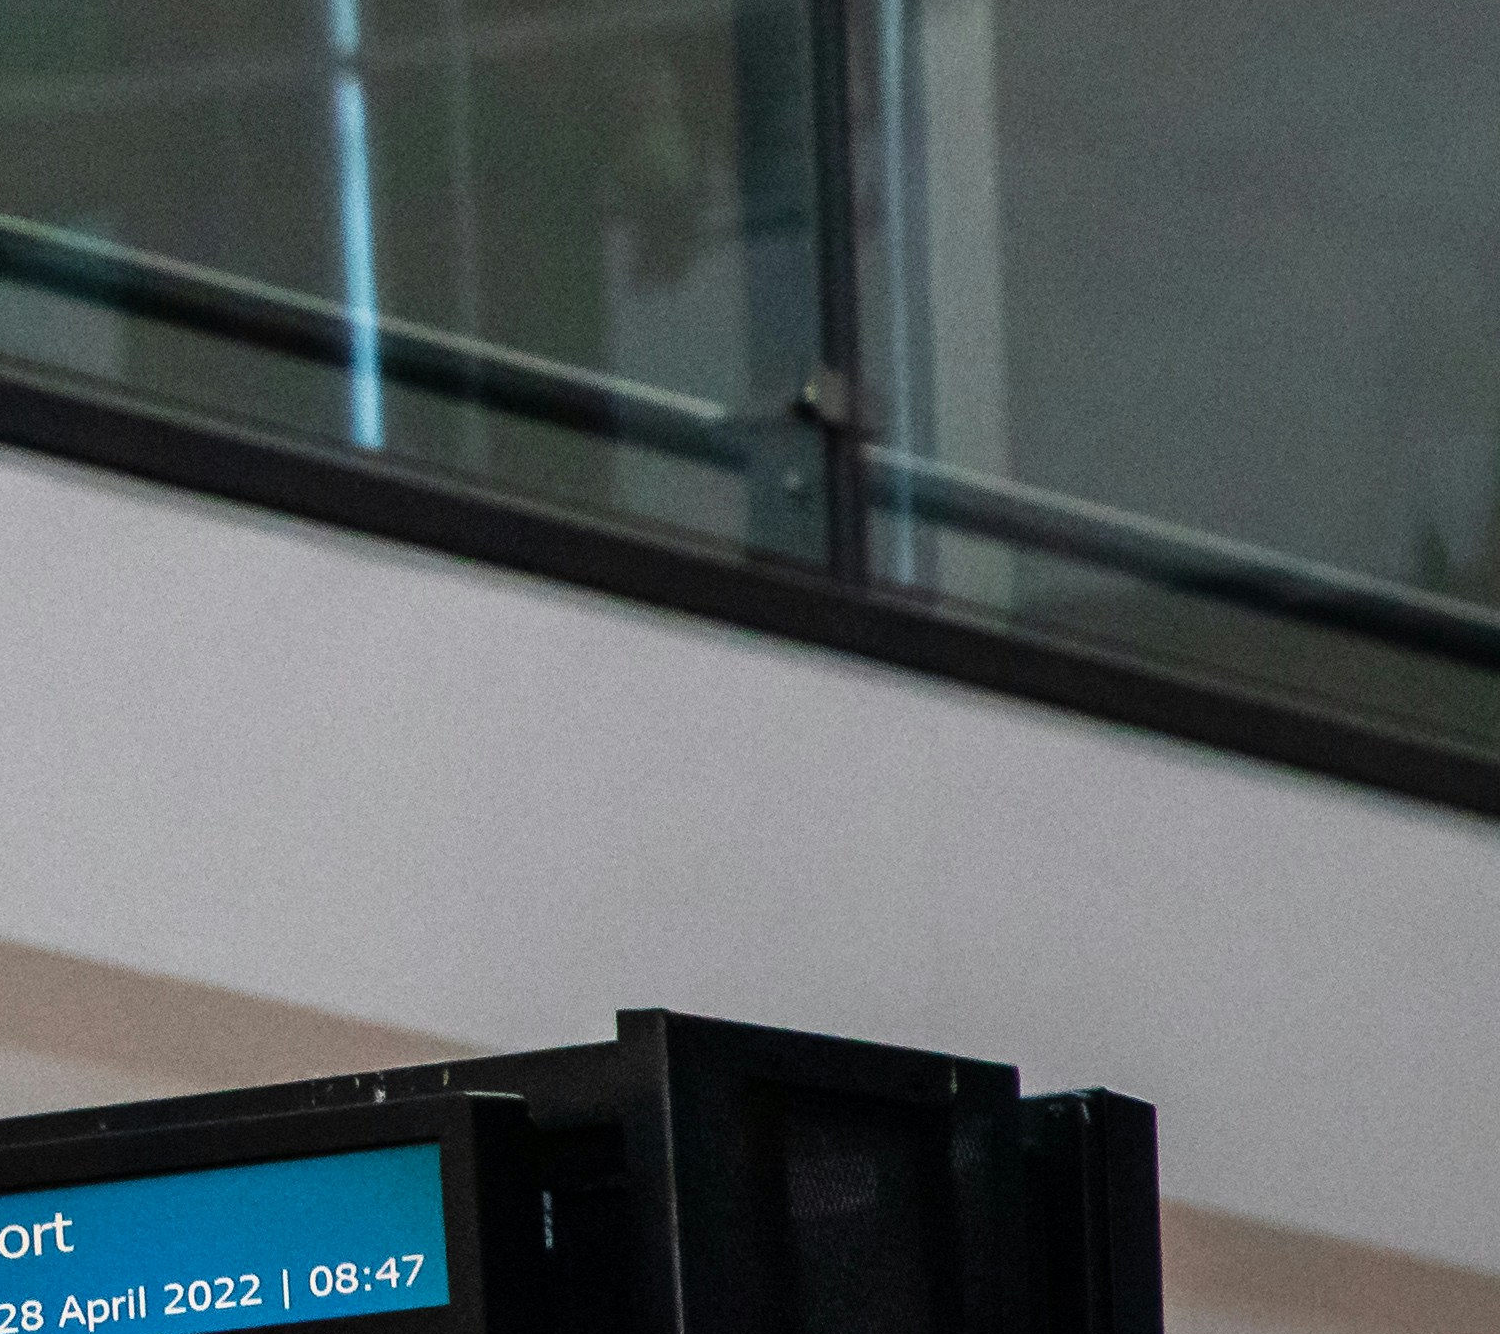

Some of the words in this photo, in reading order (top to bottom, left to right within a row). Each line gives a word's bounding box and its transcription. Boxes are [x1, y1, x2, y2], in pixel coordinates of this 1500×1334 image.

[58, 1285, 147, 1333] April
[164, 1273, 263, 1315] 2022
[309, 1254, 424, 1297] 08:47
